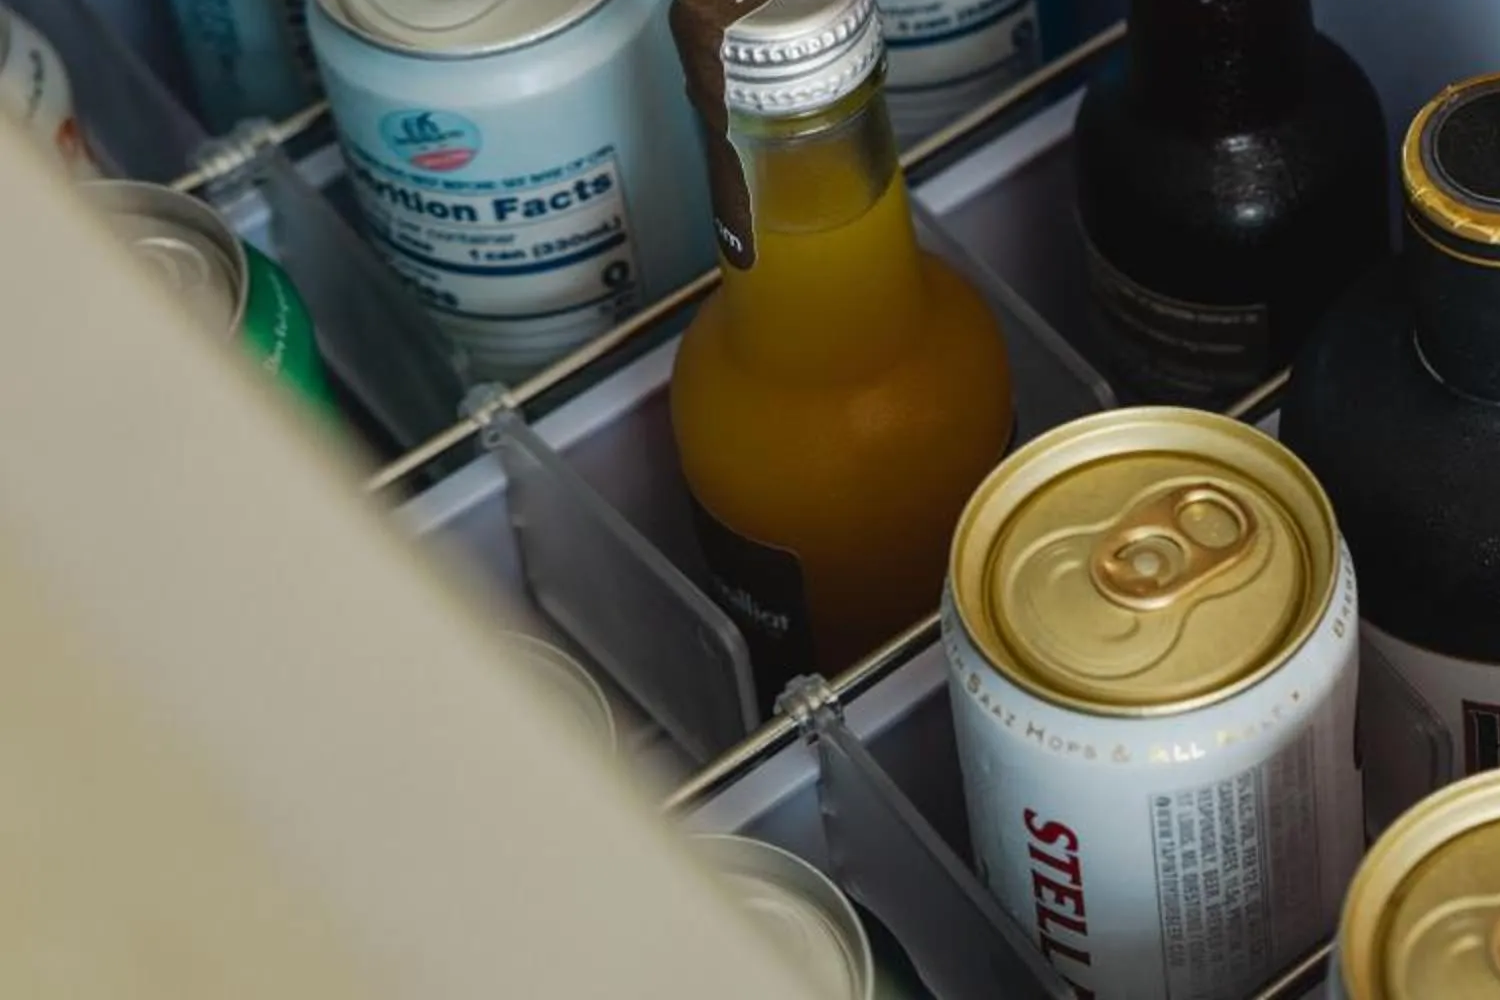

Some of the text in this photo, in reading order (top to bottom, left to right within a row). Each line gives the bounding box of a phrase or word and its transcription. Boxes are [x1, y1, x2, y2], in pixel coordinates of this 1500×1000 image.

[492, 172, 614, 223] Facts
[966, 671, 1017, 728] SAAZ
[1026, 720, 1099, 762] HOPS
